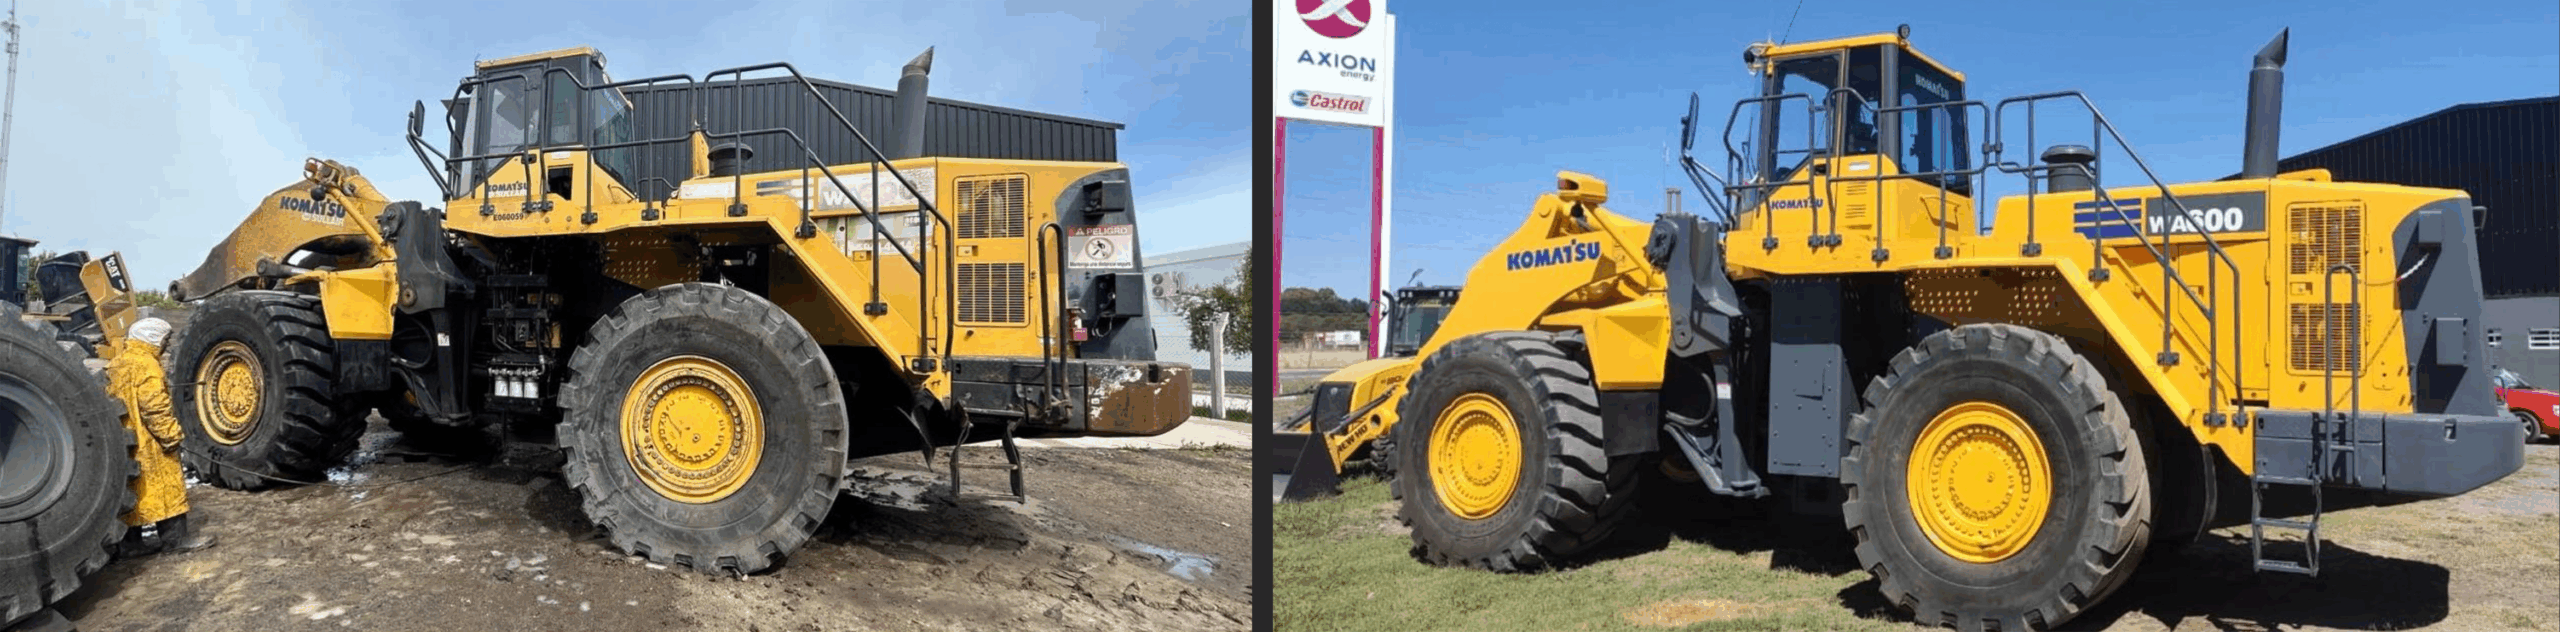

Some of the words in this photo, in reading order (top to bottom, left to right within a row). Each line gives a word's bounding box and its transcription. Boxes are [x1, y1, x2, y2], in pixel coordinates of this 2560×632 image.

[1297, 49, 1376, 73] AXION
[1340, 70, 1375, 82] energy
[1310, 94, 1365, 112] Castrol
[280, 196, 346, 219] KOMATSU
[1771, 198, 1823, 210] KOMATU
[1086, 227, 1128, 236] PELIGRO
[2149, 207, 2243, 234] WA600
[1507, 239, 1600, 271] KOMATSU
[105, 256, 121, 278] CAT
